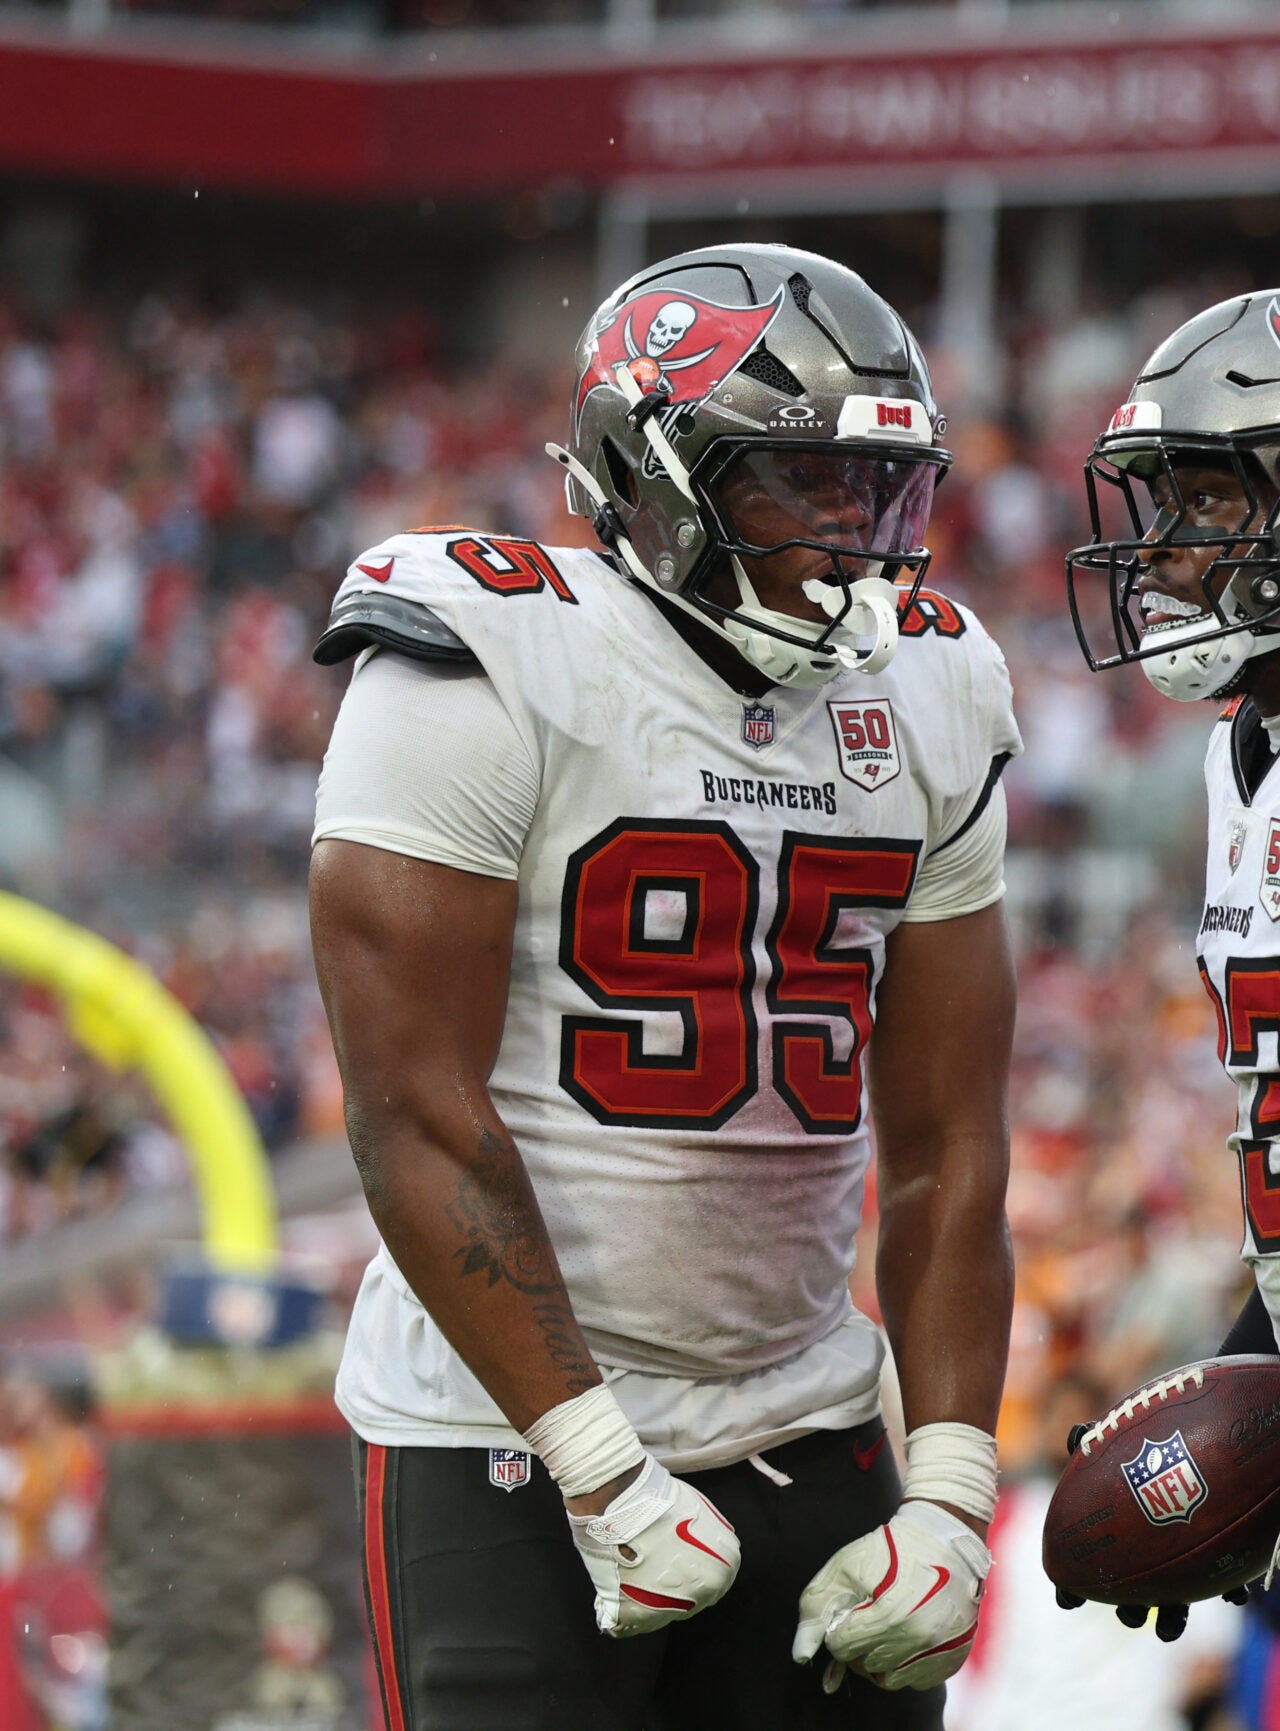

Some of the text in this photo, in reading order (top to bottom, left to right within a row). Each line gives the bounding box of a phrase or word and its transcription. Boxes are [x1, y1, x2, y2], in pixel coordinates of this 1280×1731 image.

[769, 420, 826, 428] OAKLEY
[746, 721, 772, 743] NFL
[836, 709, 891, 750] 50
[699, 769, 837, 815] BUCCANEERS
[558, 816, 923, 1135] 95
[495, 1461, 525, 1483] NFL
[1140, 1465, 1201, 1519] NFL
